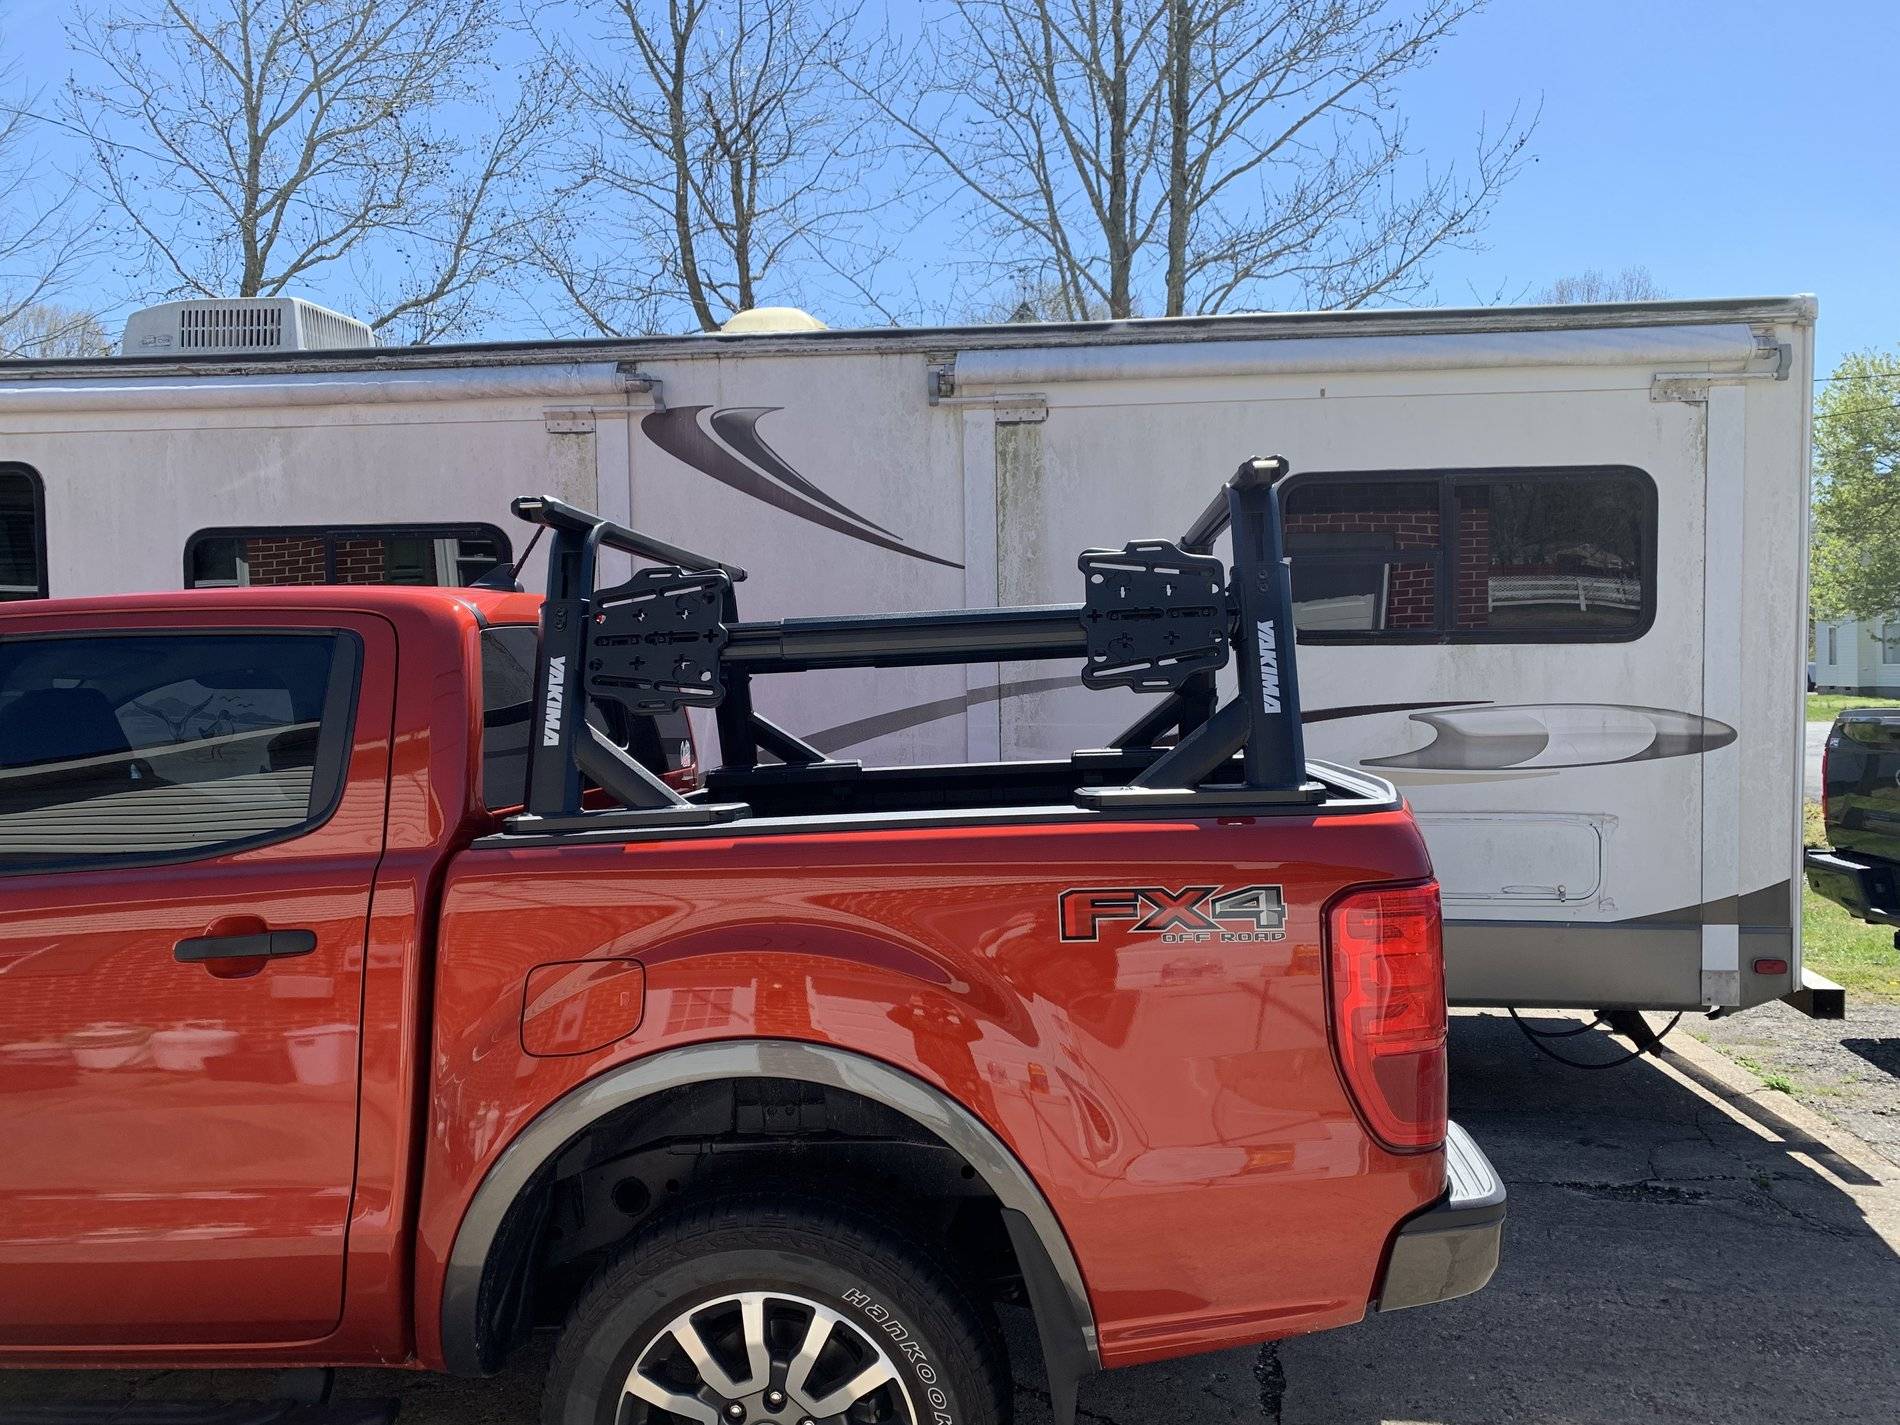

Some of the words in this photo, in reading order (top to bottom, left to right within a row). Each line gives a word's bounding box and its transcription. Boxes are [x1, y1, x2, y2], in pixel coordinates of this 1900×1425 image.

[543, 655, 566, 747] YAKIMA
[1257, 619, 1282, 714] YAKIMA
[1057, 884, 1289, 943] FX4
[1161, 932, 1211, 943] OFF
[1220, 931, 1287, 943] ROAD
